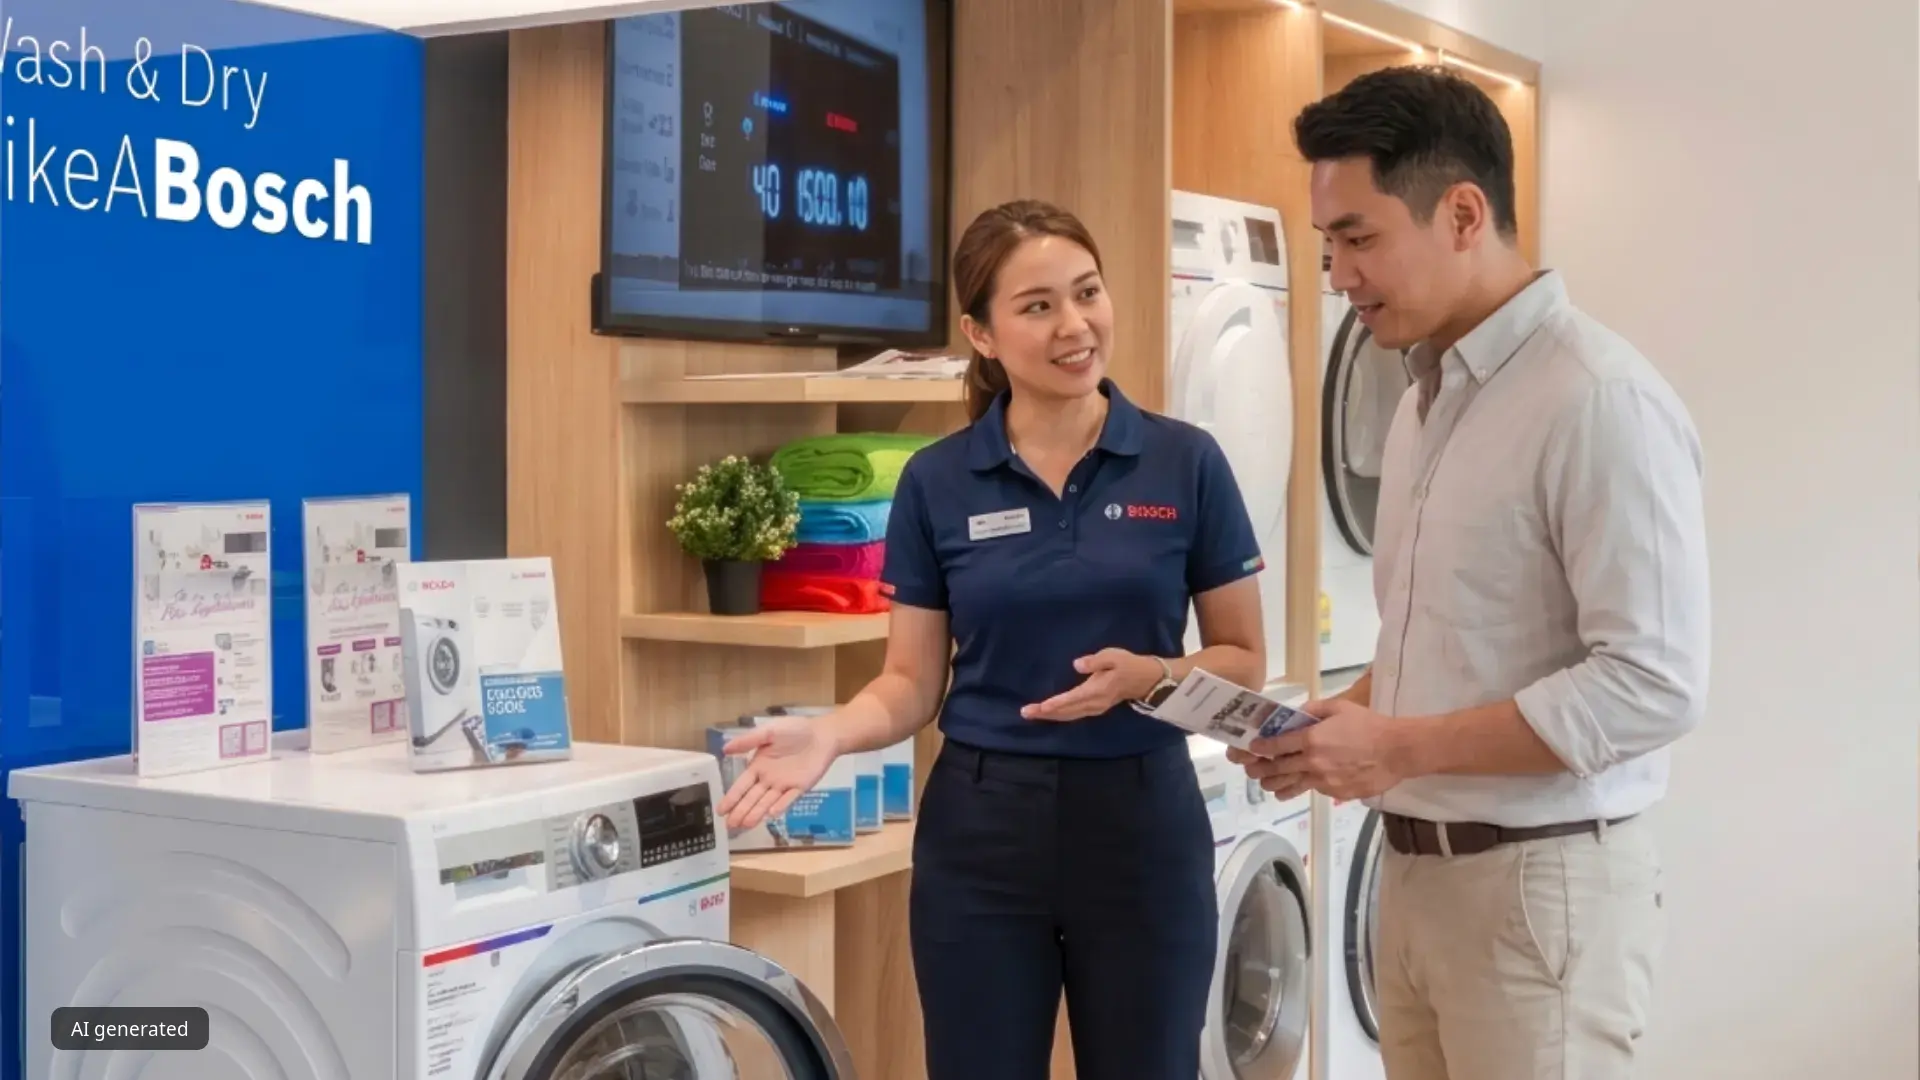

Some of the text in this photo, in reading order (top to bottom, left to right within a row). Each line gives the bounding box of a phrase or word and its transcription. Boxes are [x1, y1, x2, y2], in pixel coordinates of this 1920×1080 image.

[126, 36, 161, 102] &
[181, 42, 268, 129] Dry
[6, 115, 372, 245] ikeABosch
[753, 164, 780, 218] 40
